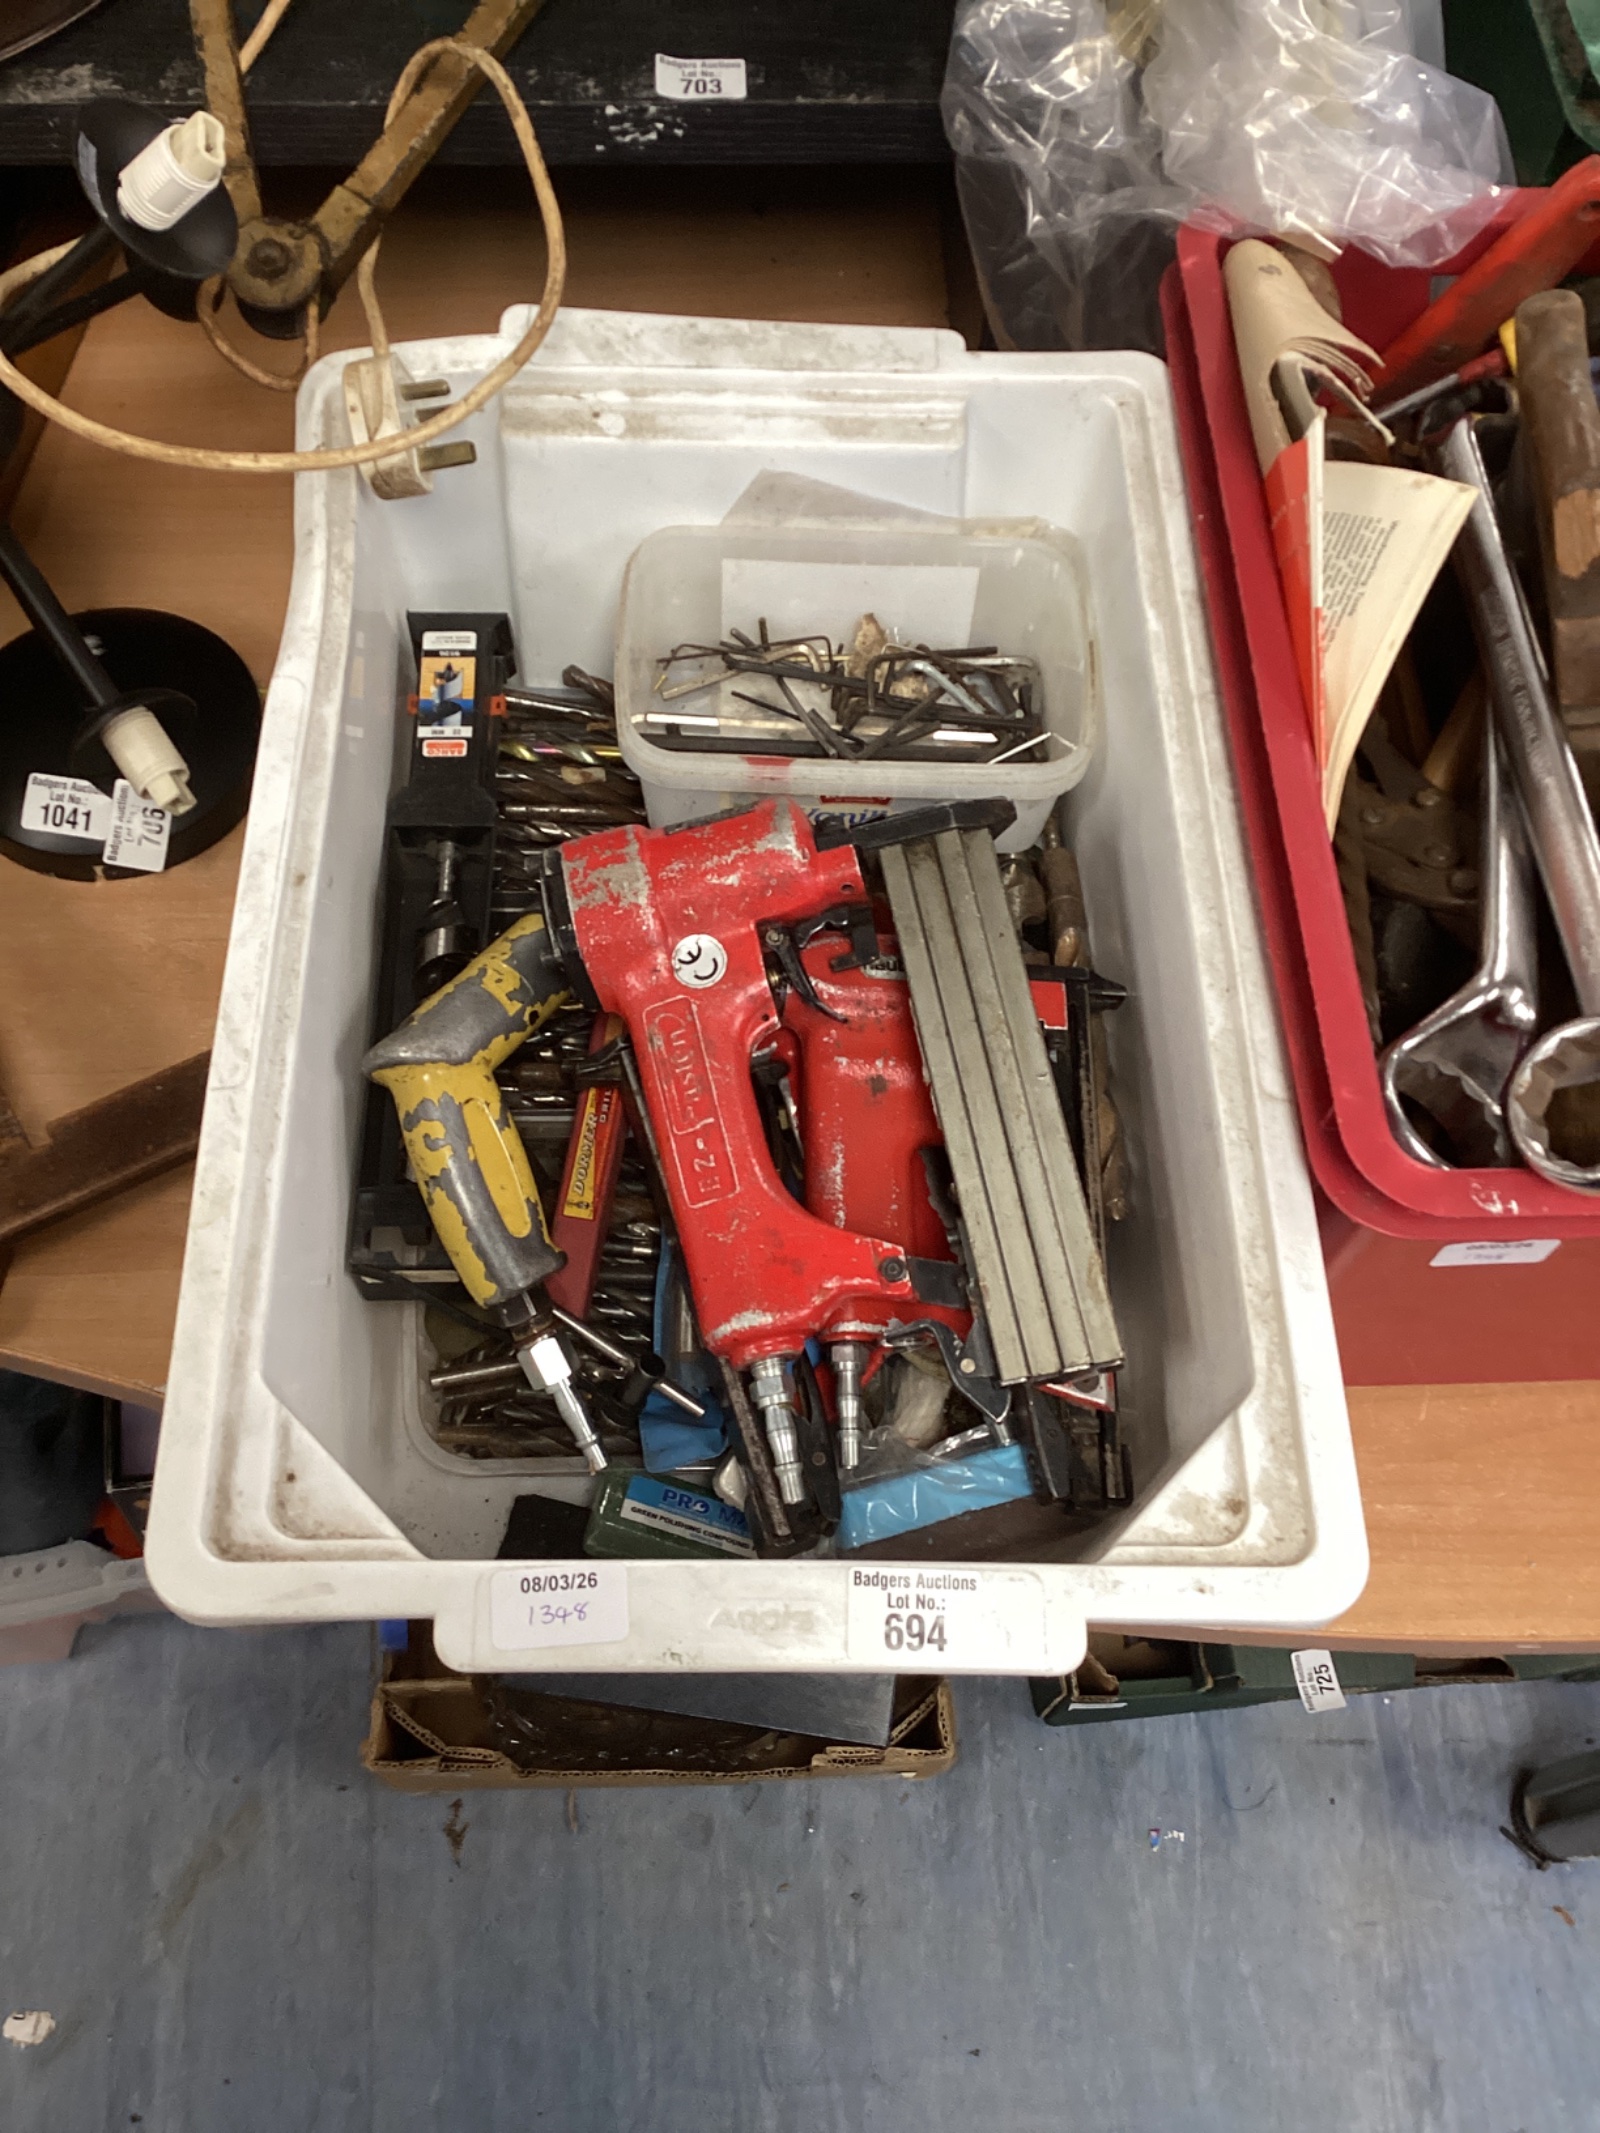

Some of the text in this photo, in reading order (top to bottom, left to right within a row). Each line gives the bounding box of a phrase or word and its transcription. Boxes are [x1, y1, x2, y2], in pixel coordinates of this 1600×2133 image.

[680, 78, 722, 94] 703
[31, 775, 68, 791] Badgers
[50, 791, 65, 802] Lot
[40, 803, 92, 832] 1041
[137, 806, 166, 847] 706
[106, 824, 124, 862] Badgers
[573, 1111, 598, 1197] DORMER
[661, 1488, 711, 1515] PRO
[630, 1505, 659, 1520] GREEN
[658, 1515, 702, 1534] POLISHING
[702, 1529, 751, 1550] COMPOUND
[520, 1571, 598, 1594] 08/03/26
[853, 1570, 977, 1591] Badgers Auctions
[528, 1601, 590, 1626] 1348
[887, 1592, 946, 1611] Lot No.:
[884, 1613, 948, 1652] 694
[1313, 1664, 1336, 1695] 725
